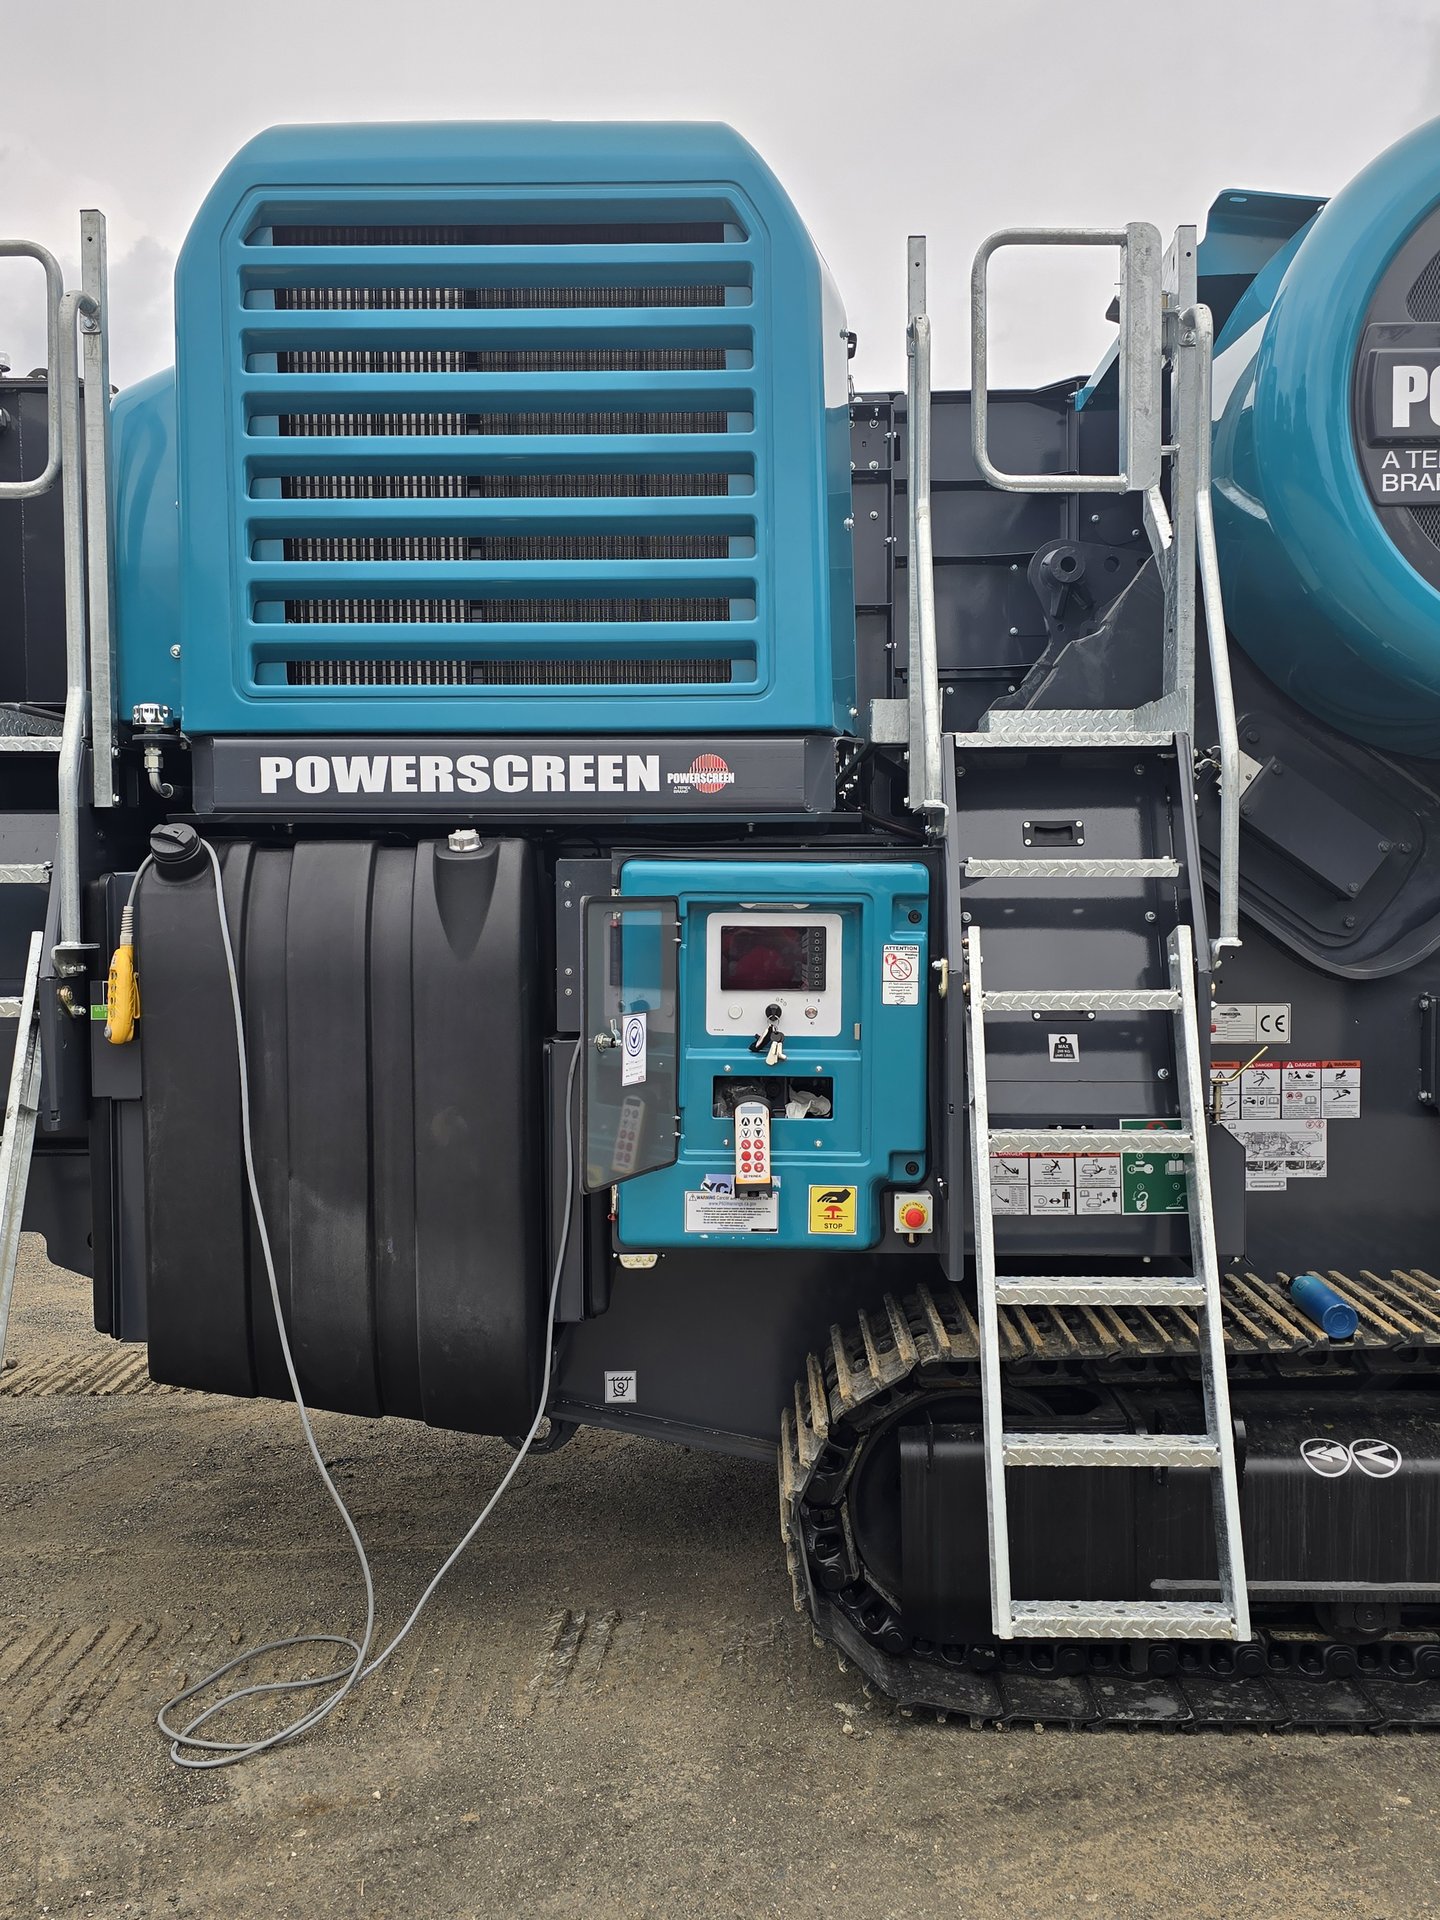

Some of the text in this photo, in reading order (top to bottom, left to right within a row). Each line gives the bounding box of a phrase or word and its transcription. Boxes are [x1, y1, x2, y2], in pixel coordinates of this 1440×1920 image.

[1381, 450, 1401, 469] A
[260, 754, 660, 795] POWERSCREEN
[667, 772, 735, 784] POWERSCREEN
